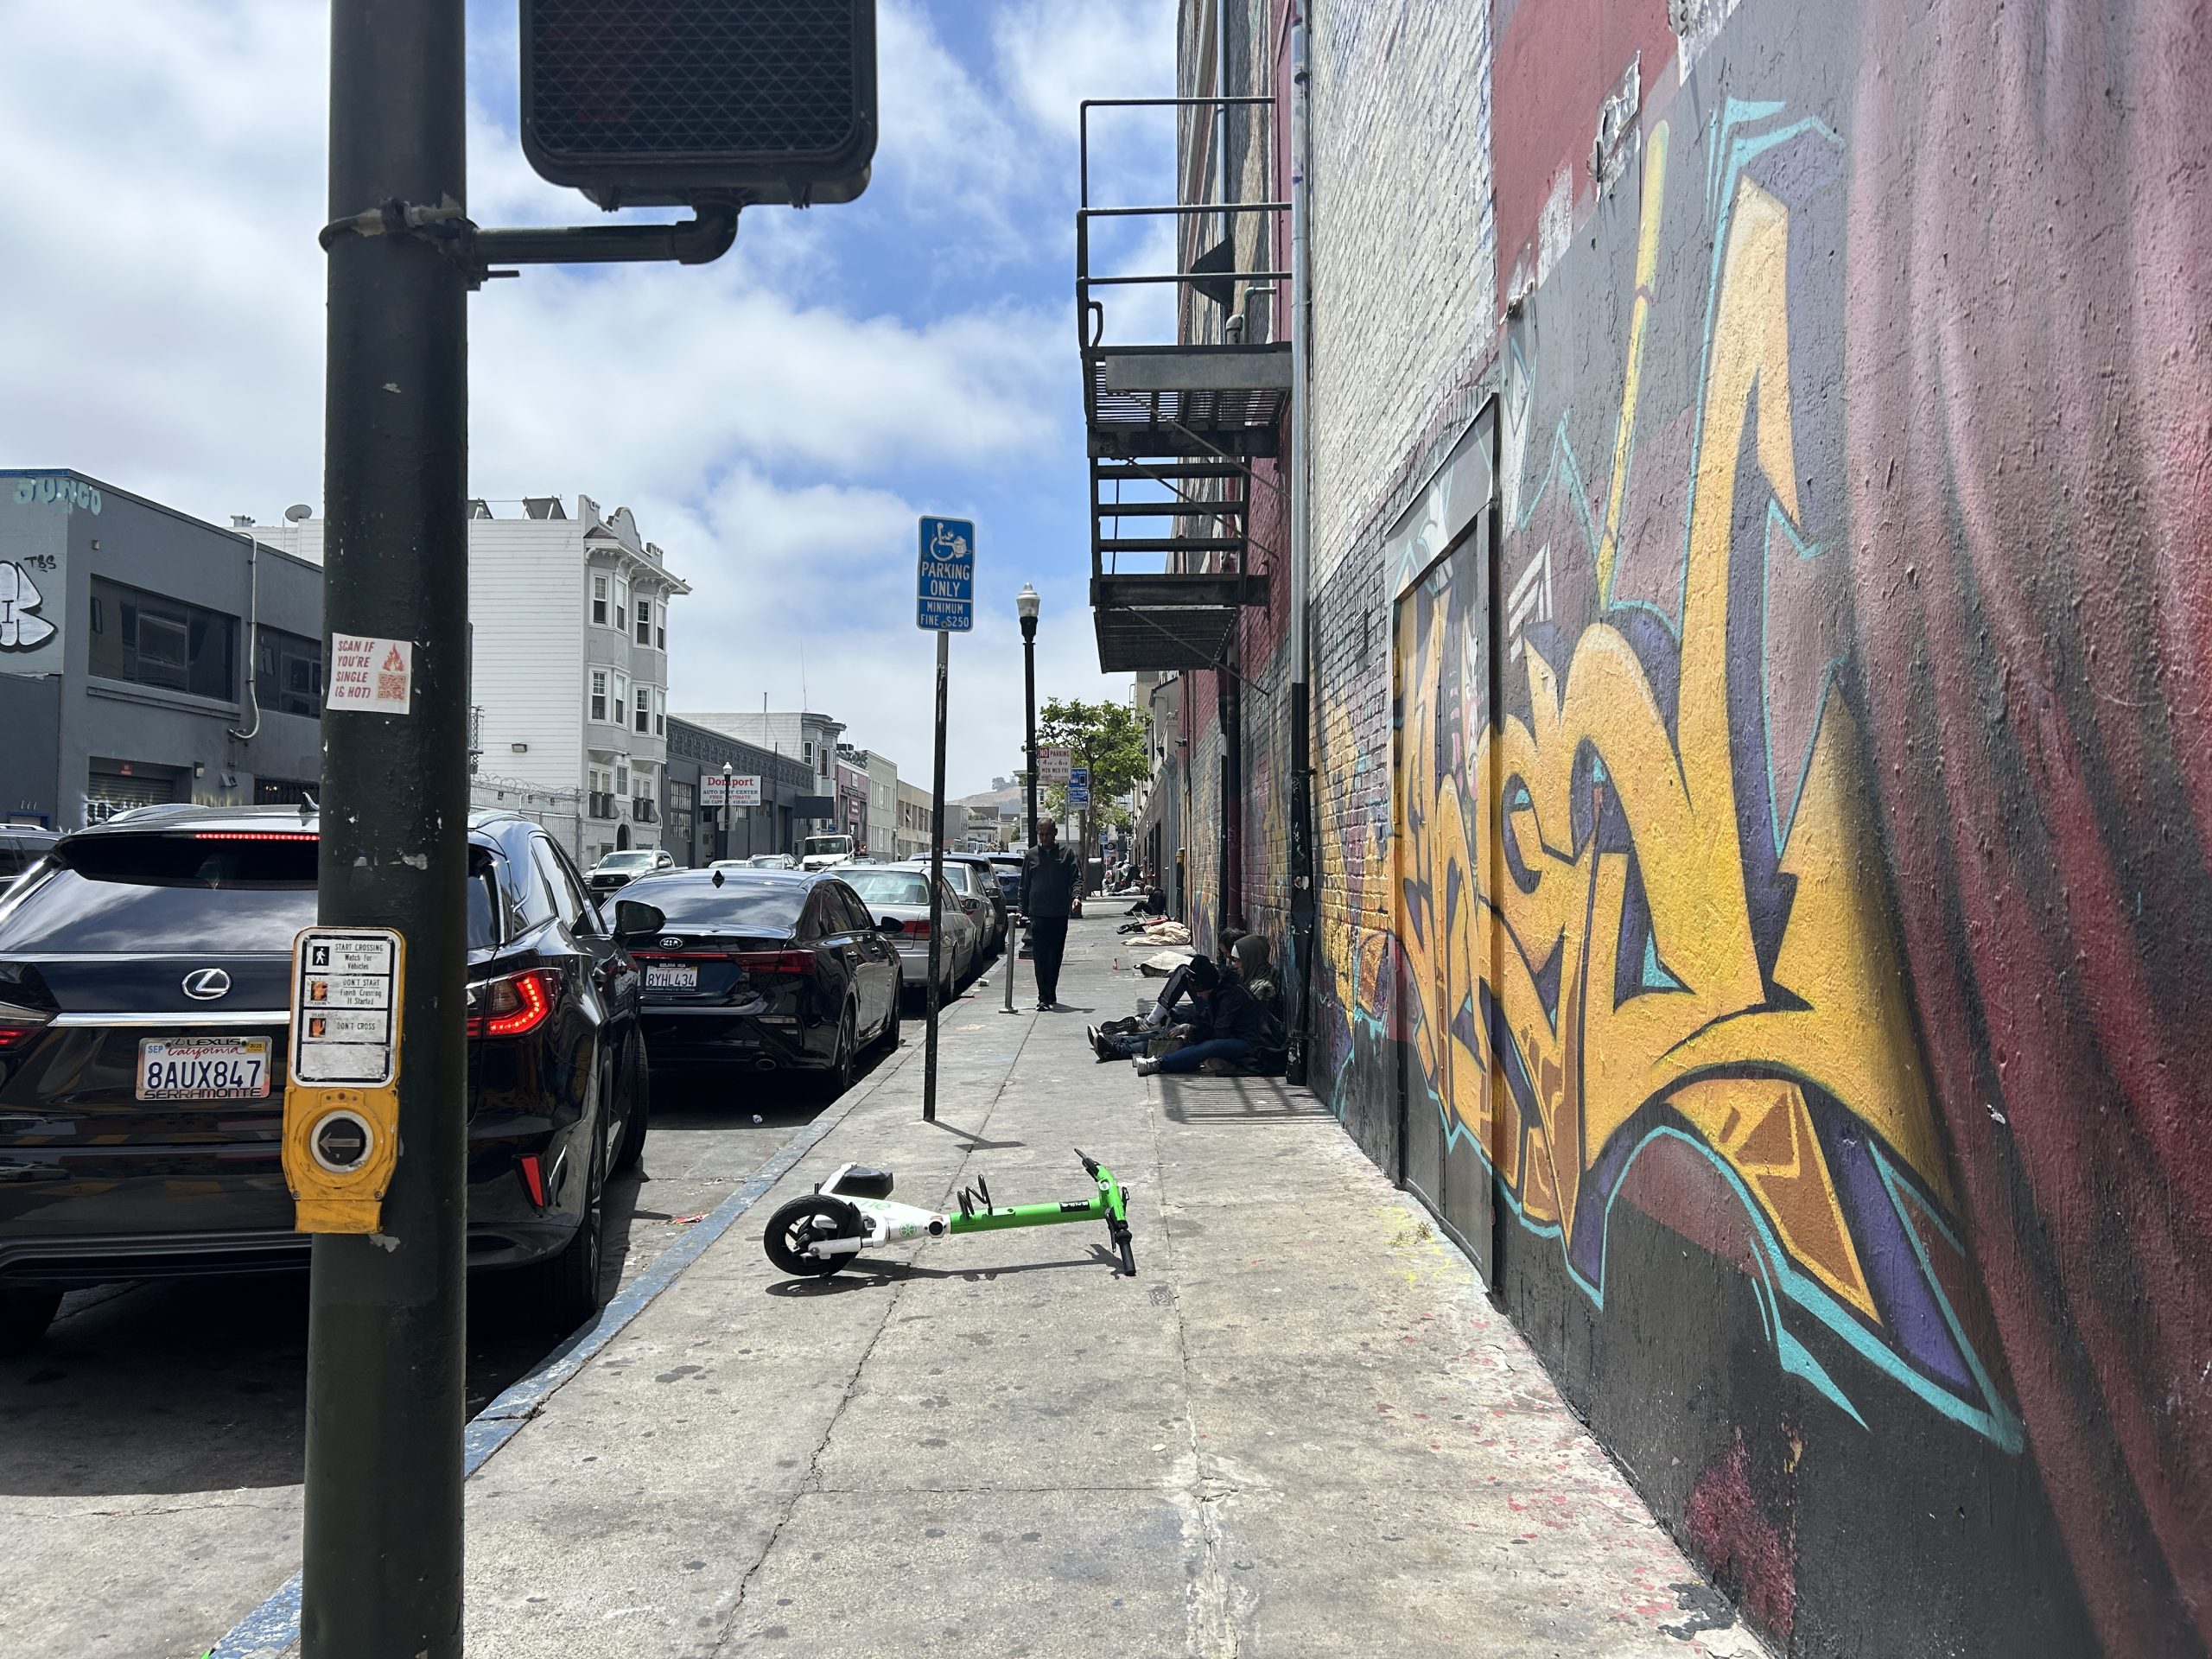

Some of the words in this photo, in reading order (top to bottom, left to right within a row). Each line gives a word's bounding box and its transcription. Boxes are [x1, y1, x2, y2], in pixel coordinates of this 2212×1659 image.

[921, 561, 970, 581] PARKING
[930, 580, 961, 598] ONLY
[926, 601, 963, 614] MINIMUM
[920, 614, 939, 626] FINE
[945, 615, 969, 627] $250
[338, 640, 361, 652] SCAN
[364, 642, 375, 652] IF
[337, 656, 371, 668] YOU'RE
[336, 671, 368, 683] SINGLE
[334, 686, 345, 697] (&
[347, 687, 372, 698] HOT)
[1039, 748, 1048, 757] NO
[648, 973, 695, 987] 8YHL434
[359, 989, 382, 998] Crossing
[187, 1038, 241, 1046] LEXUS
[148, 1060, 261, 1089] 8AUX847
[144, 1088, 261, 1099] SERRAMONTE
